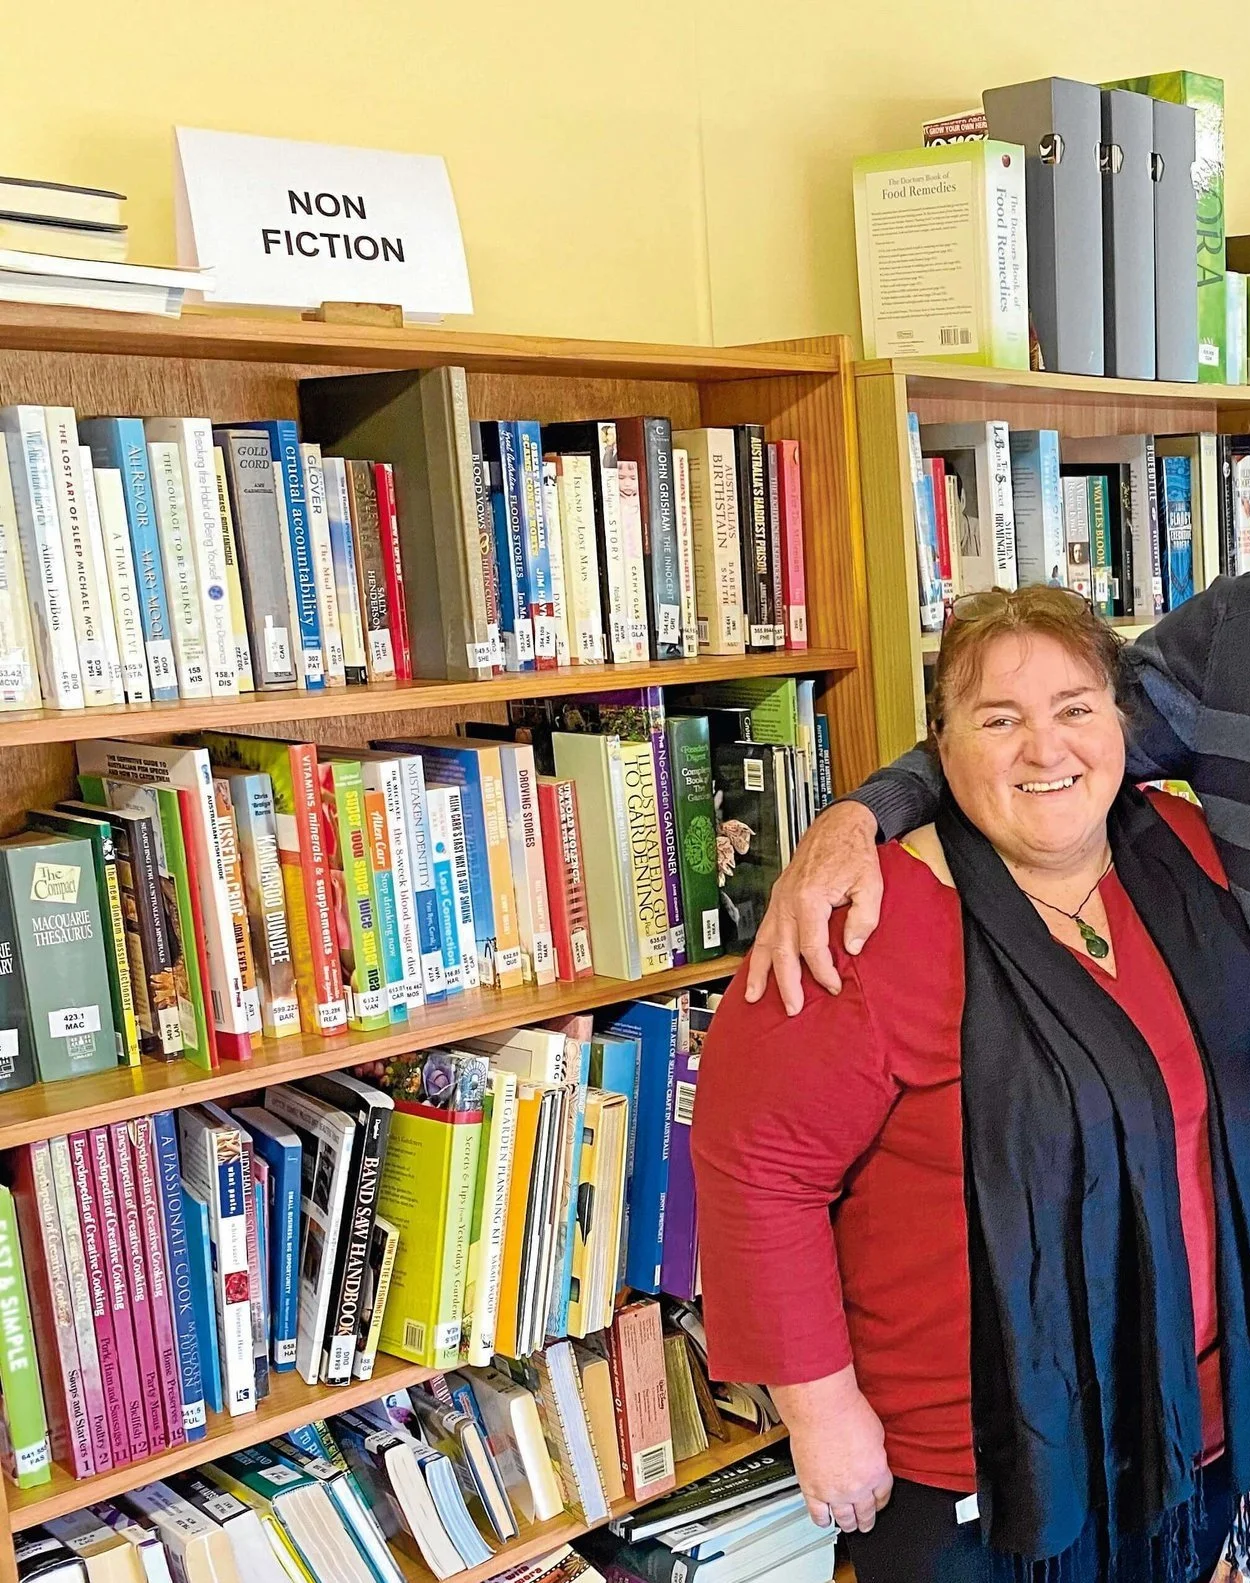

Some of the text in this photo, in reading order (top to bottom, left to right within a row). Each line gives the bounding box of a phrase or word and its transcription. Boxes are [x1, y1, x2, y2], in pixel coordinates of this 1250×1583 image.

[288, 190, 366, 219] NON
[882, 181, 957, 200] Food Remedies
[261, 229, 405, 262] FICTION
[996, 188, 1011, 313] Food Remedies
[237, 446, 268, 457] GOLD
[240, 460, 270, 469] CORD
[307, 455, 322, 514] GLOVER
[472, 454, 486, 529] BLOOD VOWS
[1146, 445, 1156, 501] BLUEBOTTLE
[59, 424, 90, 611] THE LOST ART OF SLEEP MICHAEL
[285, 445, 318, 627] crucial accountability
[510, 495, 524, 579] FLOOD STORIES
[657, 449, 674, 601] JOHN GRISHAM INNOCENT
[712, 454, 728, 549] BIRTHSTAIN
[750, 437, 767, 575] AUSTRALIA'S HARDEST PRISON
[995, 513, 1006, 569] BIRMINGHAM
[1093, 484, 1105, 567] WATTLES BLOOM
[142, 550, 158, 591] MARY
[167, 479, 192, 625] COURAGE DISLIKED
[368, 570, 380, 631] HENDERSON
[378, 587, 387, 615] SALLY
[207, 795, 224, 880] AUSTRALIAN GUIDE
[407, 762, 431, 888] MISTAKEN IDENTITY
[519, 770, 535, 848] DROVING STORIES
[625, 760, 655, 922] TO GARDENING
[637, 753, 664, 895] ILLUSTRATED
[659, 750, 677, 877] No-Garden GARDENER
[34, 879, 77, 901] Compact
[218, 815, 243, 917] KISSED CROC
[257, 834, 290, 966] KANGAROO DUNDEE
[308, 812, 333, 955] minerals supplements
[370, 810, 396, 936] Allen drinking
[395, 848, 414, 954] 8-week blood sugar
[32, 910, 91, 934] MACQUARIE
[33, 924, 93, 947] THESAURUS
[155, 927, 166, 963] MINERALS
[358, 898, 374, 929] juice
[439, 871, 455, 965] Lost Connection
[460, 896, 471, 924] SMOKING
[111, 903, 132, 1011] dinkum aussie dictionary
[63, 1013, 85, 1022] 423.1
[65, 1022, 85, 1031] MAC
[279, 1013, 295, 1021] BAR
[453, 1136, 473, 1277] Secrets Yesterday's
[493, 1107, 512, 1225] GARDEN PLANNING
[73, 1139, 105, 1317] Encyclopedia Creative Cooking
[95, 1133, 126, 1311] Encyclopedia Creative Cooking
[116, 1126, 146, 1302] Encyclopedia Creative Cooking
[137, 1123, 164, 1298] Encyclopedia Creative Cooking
[161, 1136, 193, 1316] A PASSIONATE COOK
[338, 1156, 380, 1337] BAND SAW HANDBOOK
[1, 1296, 29, 1373] SIMPLE
[179, 1334, 197, 1387] FULTON
[188, 1322, 202, 1394] MARGARET
[68, 1369, 88, 1458] Soups and Starters
[110, 1402, 122, 1447] Sausages
[129, 1400, 147, 1454] Shellfish 12
[146, 1371, 160, 1430] Party Menus
[163, 1348, 184, 1441] Home Preserves 19
[183, 1417, 200, 1426] FUL
[94, 1414, 109, 1465] Poultry 2
